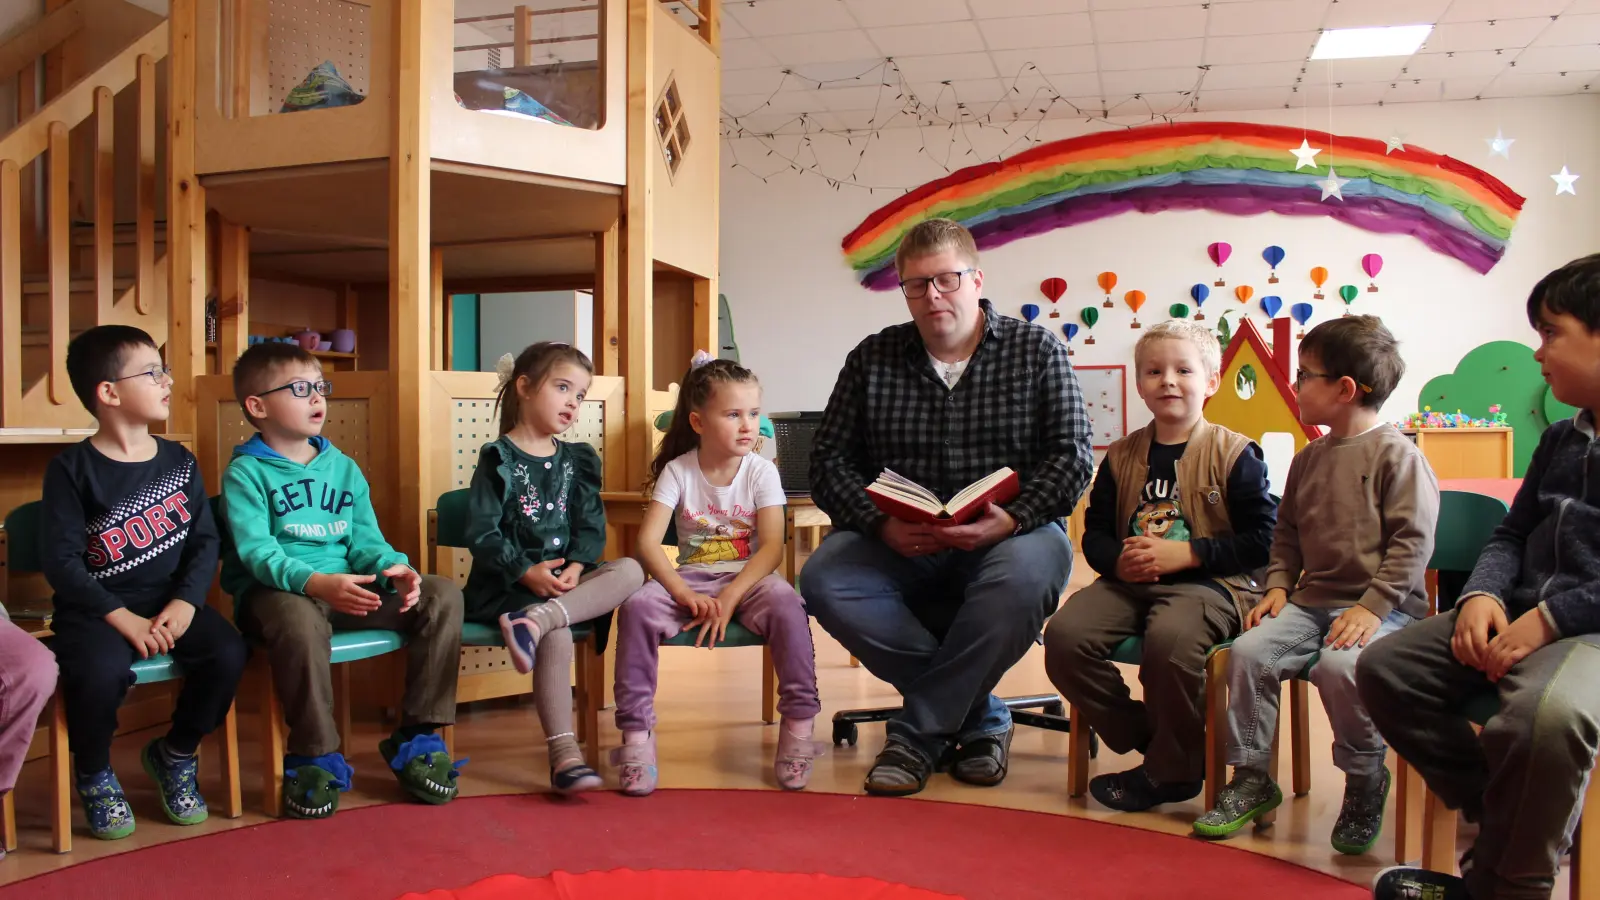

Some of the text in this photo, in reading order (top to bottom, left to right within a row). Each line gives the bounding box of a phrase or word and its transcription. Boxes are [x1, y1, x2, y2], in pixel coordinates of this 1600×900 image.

[270, 478, 354, 517] GET UP
[707, 503, 729, 517] Your
[87, 490, 192, 567] SPORT
[284, 520, 348, 537] STAND UP
